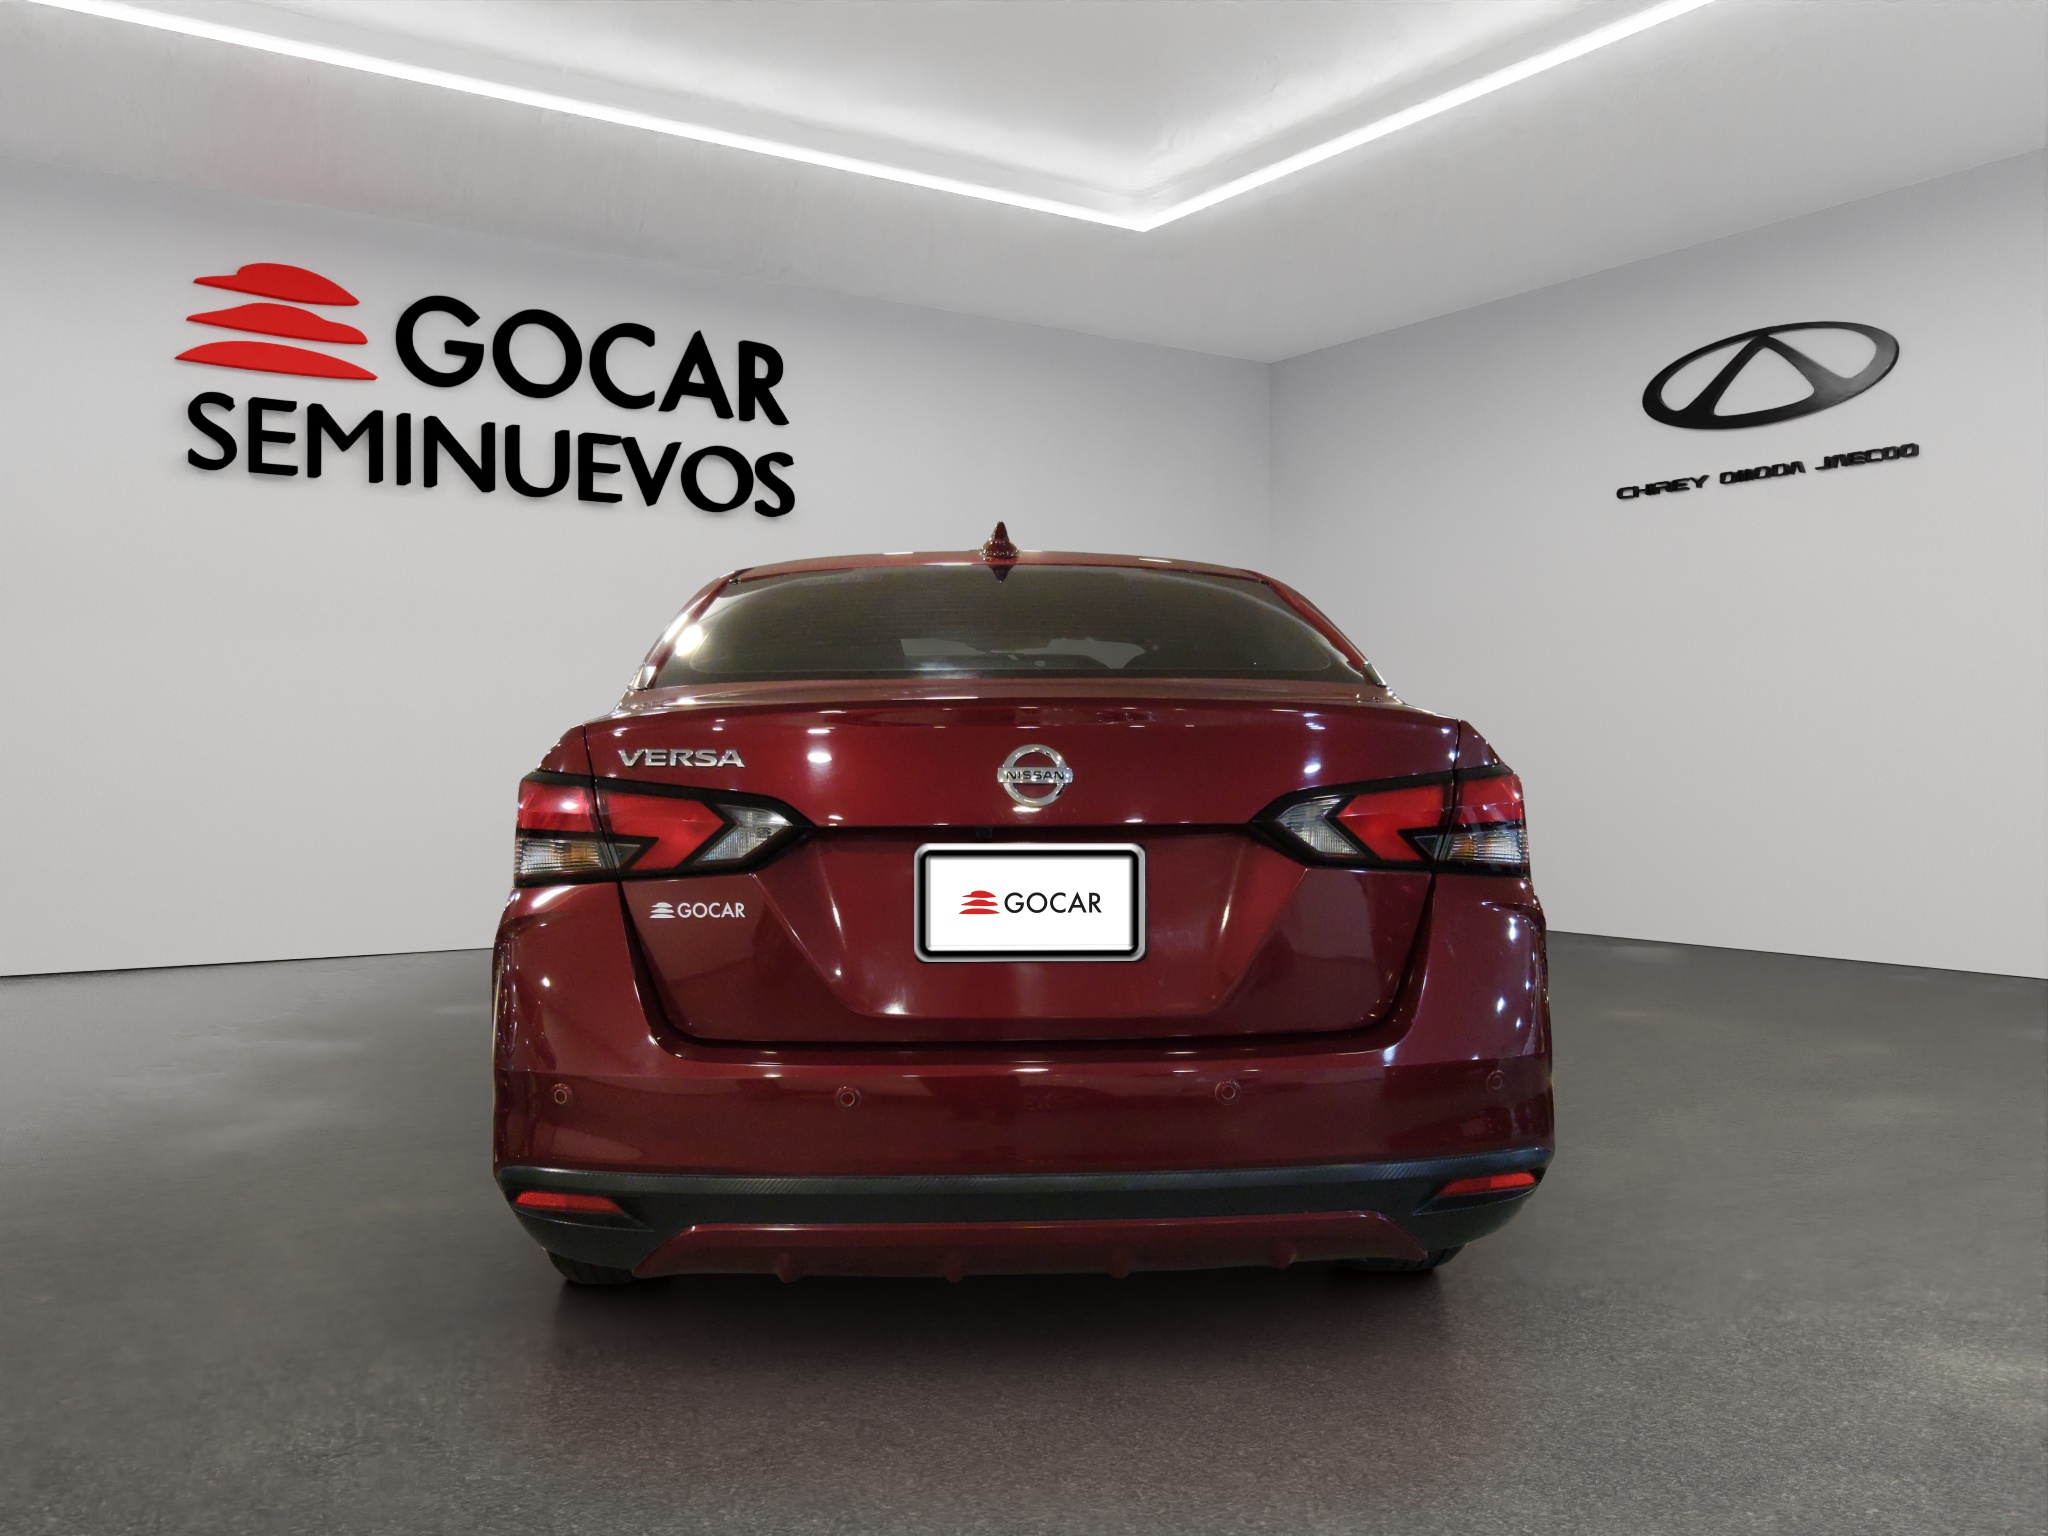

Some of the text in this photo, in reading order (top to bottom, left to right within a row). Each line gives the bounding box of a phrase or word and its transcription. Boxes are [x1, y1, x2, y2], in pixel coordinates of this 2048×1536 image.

[396, 295, 790, 426] GOCAR
[187, 391, 796, 518] SEMINUEVOS
[617, 748, 746, 768] VERSA
[1005, 769, 1065, 781] NISSAN
[677, 902, 746, 919] GOCAR
[1004, 891, 1102, 914] GOCAR
